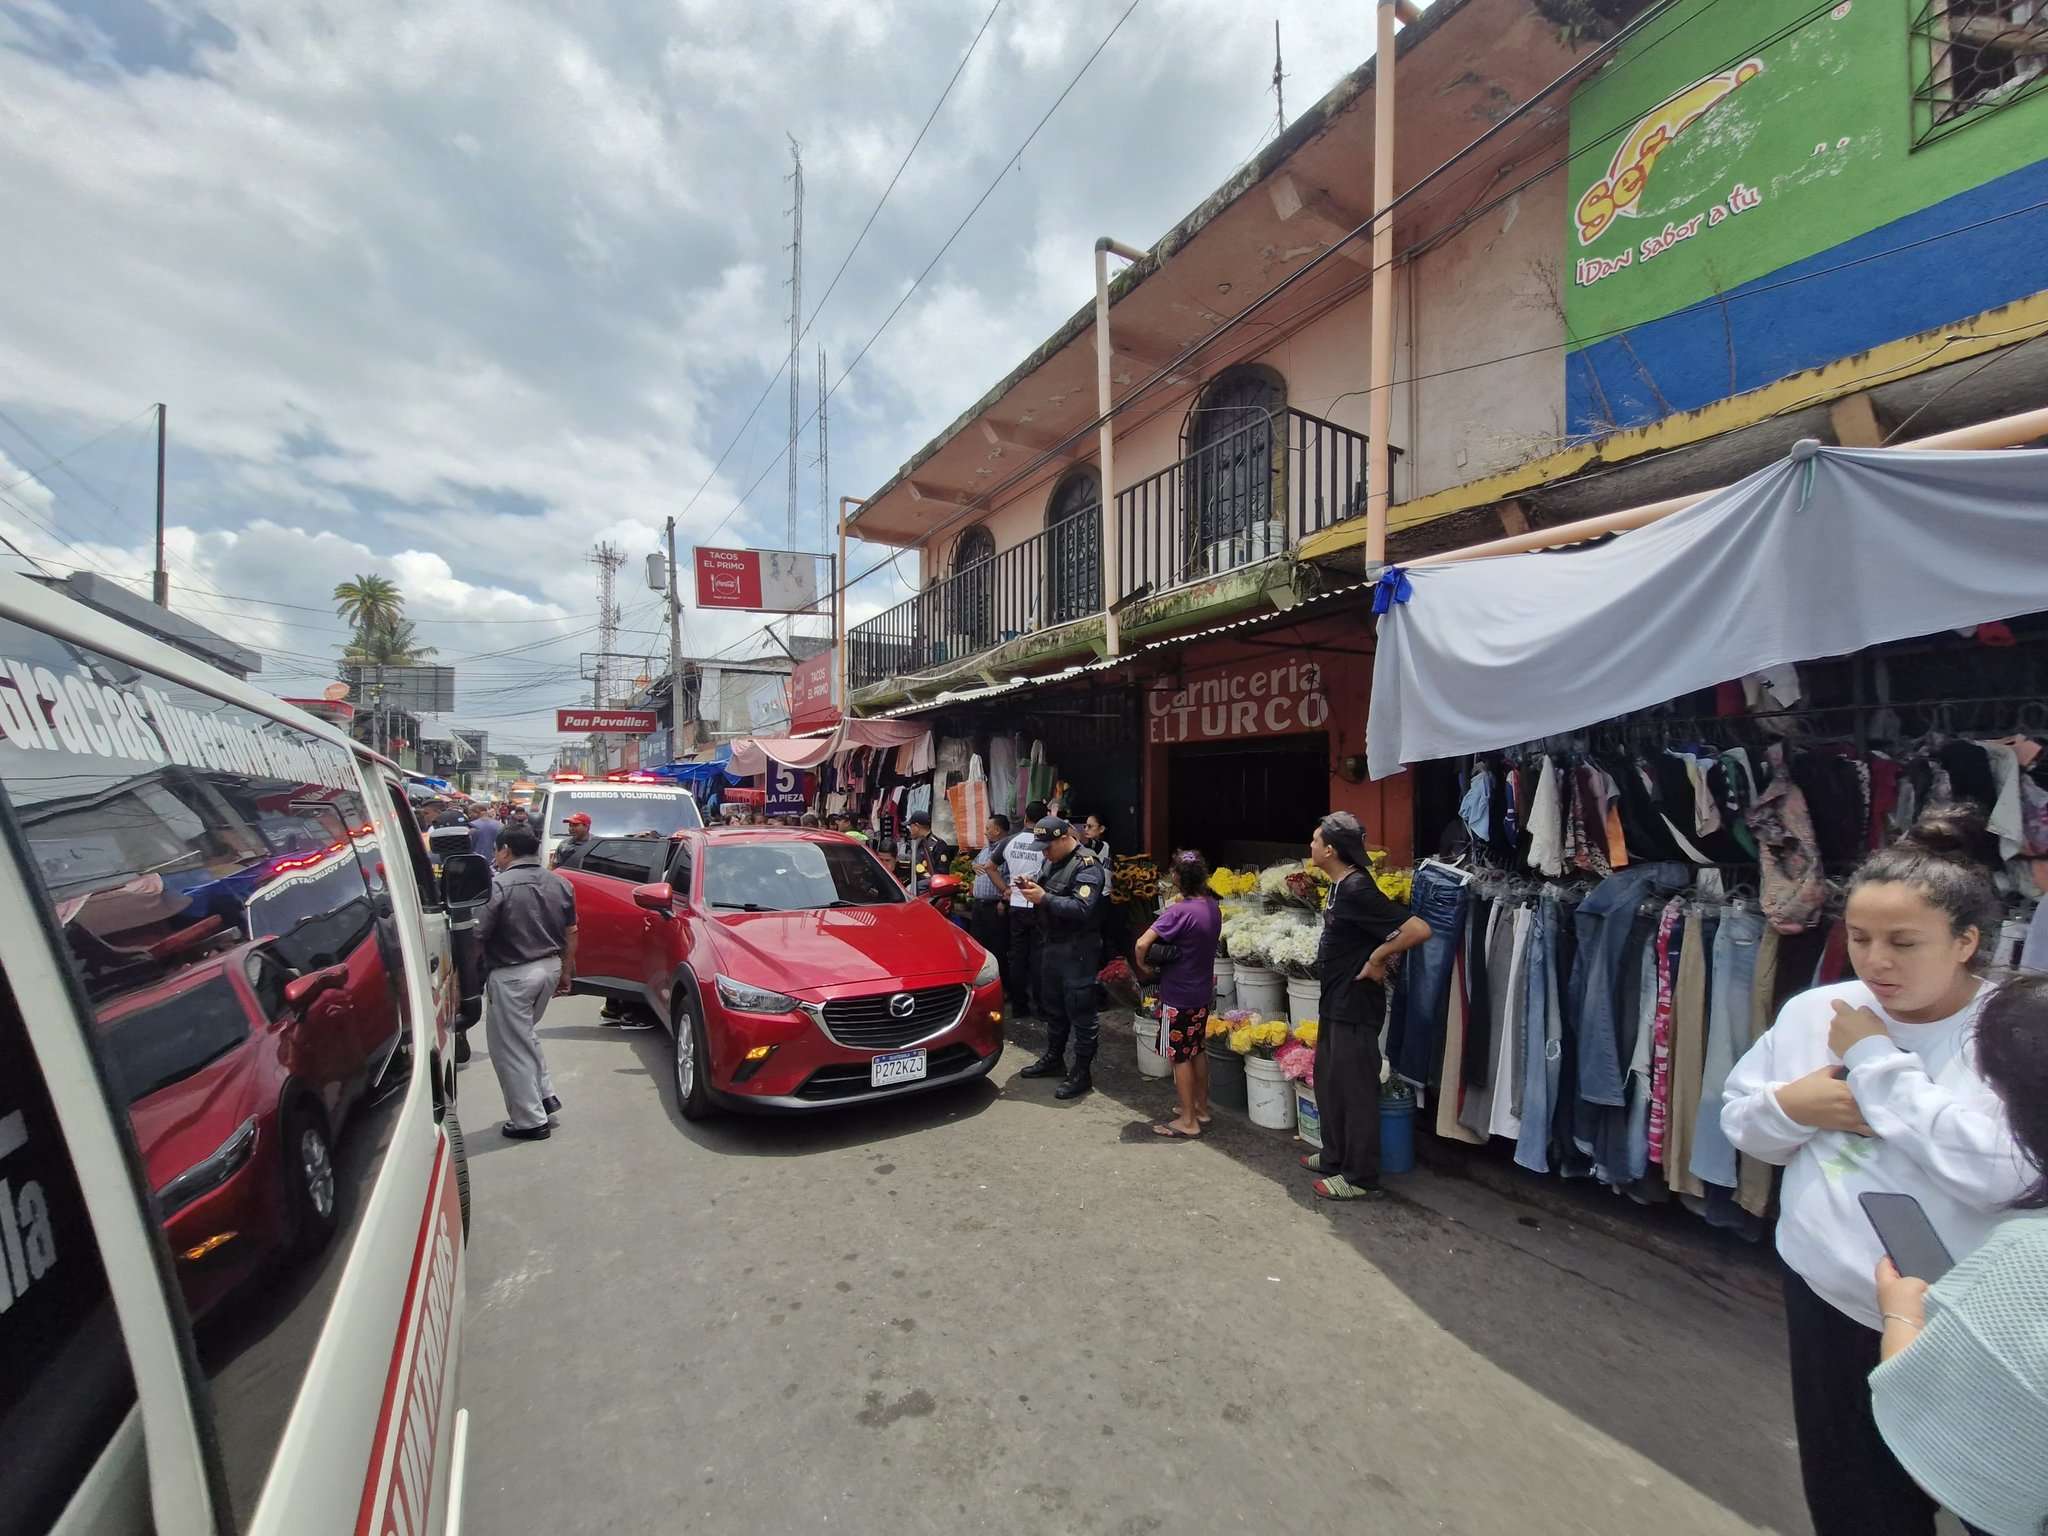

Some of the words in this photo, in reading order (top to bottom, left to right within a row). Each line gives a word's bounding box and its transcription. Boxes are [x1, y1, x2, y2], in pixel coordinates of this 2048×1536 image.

[1640, 214, 1704, 262] sabor
[1707, 205, 1729, 227] a
[1729, 184, 1762, 215] tu
[710, 551, 738, 561] TACOS
[704, 560, 715, 568] EL
[717, 561, 745, 570] PRIMO
[1149, 658, 1321, 717] Carniceria
[564, 716, 589, 727] Pan
[1150, 716, 1175, 743] EL
[1171, 692, 1329, 742] TURCO
[776, 762, 795, 792] 5
[620, 792, 677, 801] VOLUNTARIOS
[766, 794, 777, 803] LA
[779, 793, 805, 803] PIEZA
[876, 1057, 923, 1079] P272KZJ
